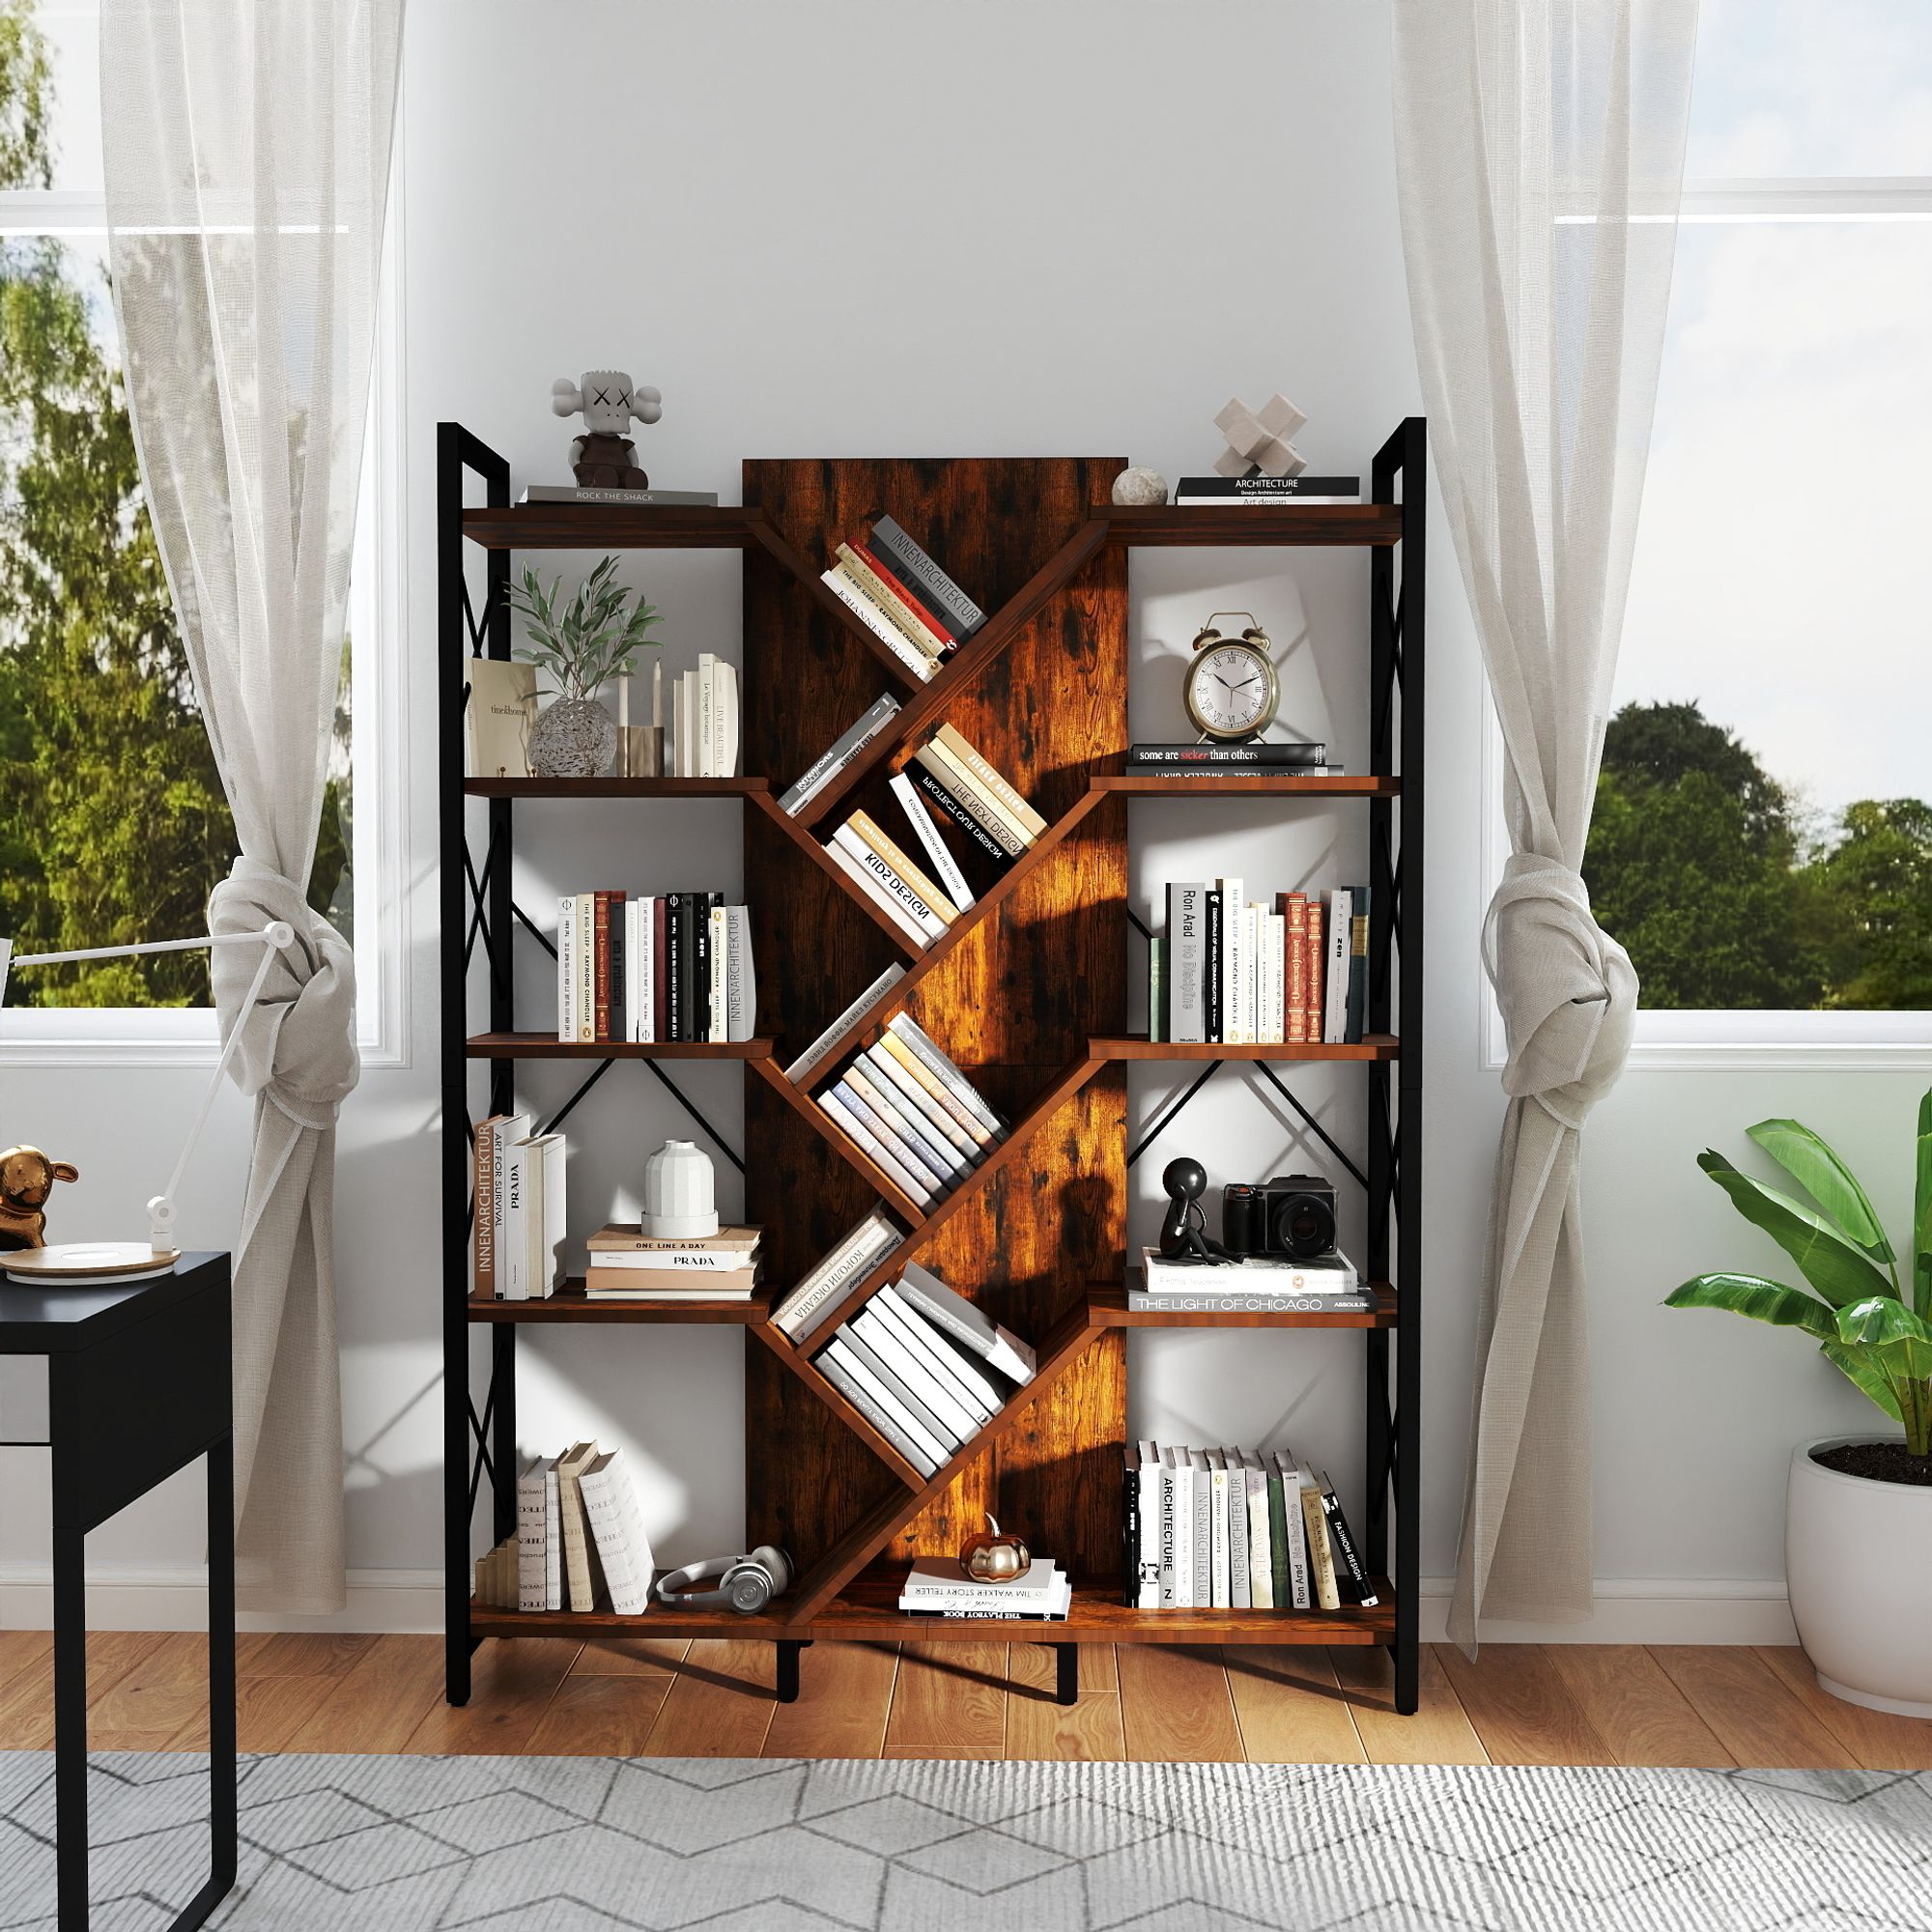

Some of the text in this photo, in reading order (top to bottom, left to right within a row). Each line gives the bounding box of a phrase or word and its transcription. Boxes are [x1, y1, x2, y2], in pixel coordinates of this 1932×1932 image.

[576, 492, 601, 500] ROCK
[1236, 479, 1298, 488] ARCHITECTURE
[854, 544, 873, 564] DUMAS
[884, 576, 895, 588] The
[895, 585, 911, 605] Black
[891, 532, 980, 624] INNENARCHITEKTUR
[842, 569, 929, 659] THE BIG SLEEP RAYMOND CHANDLER
[702, 714, 711, 745] botanique
[716, 724, 724, 765] BEAUTIFUL
[1140, 749, 1259, 760] some are sicker than others
[796, 752, 834, 790] INTERIORS
[1182, 890, 1196, 911] Ron
[1183, 913, 1196, 937] Arad
[729, 914, 741, 1022] INNENARCHITEKTUR
[806, 1045, 826, 1065] ДЭВИД
[843, 1006, 865, 1027] МАЙКЛ
[863, 978, 893, 1009] КУСУМАНО
[478, 1125, 492, 1272] INNENARCHITEKTUR
[510, 1164, 519, 1209] PRADA
[673, 1257, 715, 1265] PRADA
[874, 1236, 901, 1263] Джордан
[793, 1249, 865, 1320] КОРОЛИ ОКЕАНА
[845, 1260, 876, 1290] Элленберг
[1137, 1298, 1322, 1311] THE LIGHT OF CHICAGO
[1164, 1478, 1173, 1572] ARCHITECTURE
[1231, 1478, 1245, 1589] INNENARCHITEKTUR
[1197, 1492, 1208, 1600] INNENARCHITEKTUR
[1334, 1521, 1363, 1580] FASHION DESIGN
[1294, 1565, 1304, 1585] Arad
[947, 1588, 975, 1597] STORY
